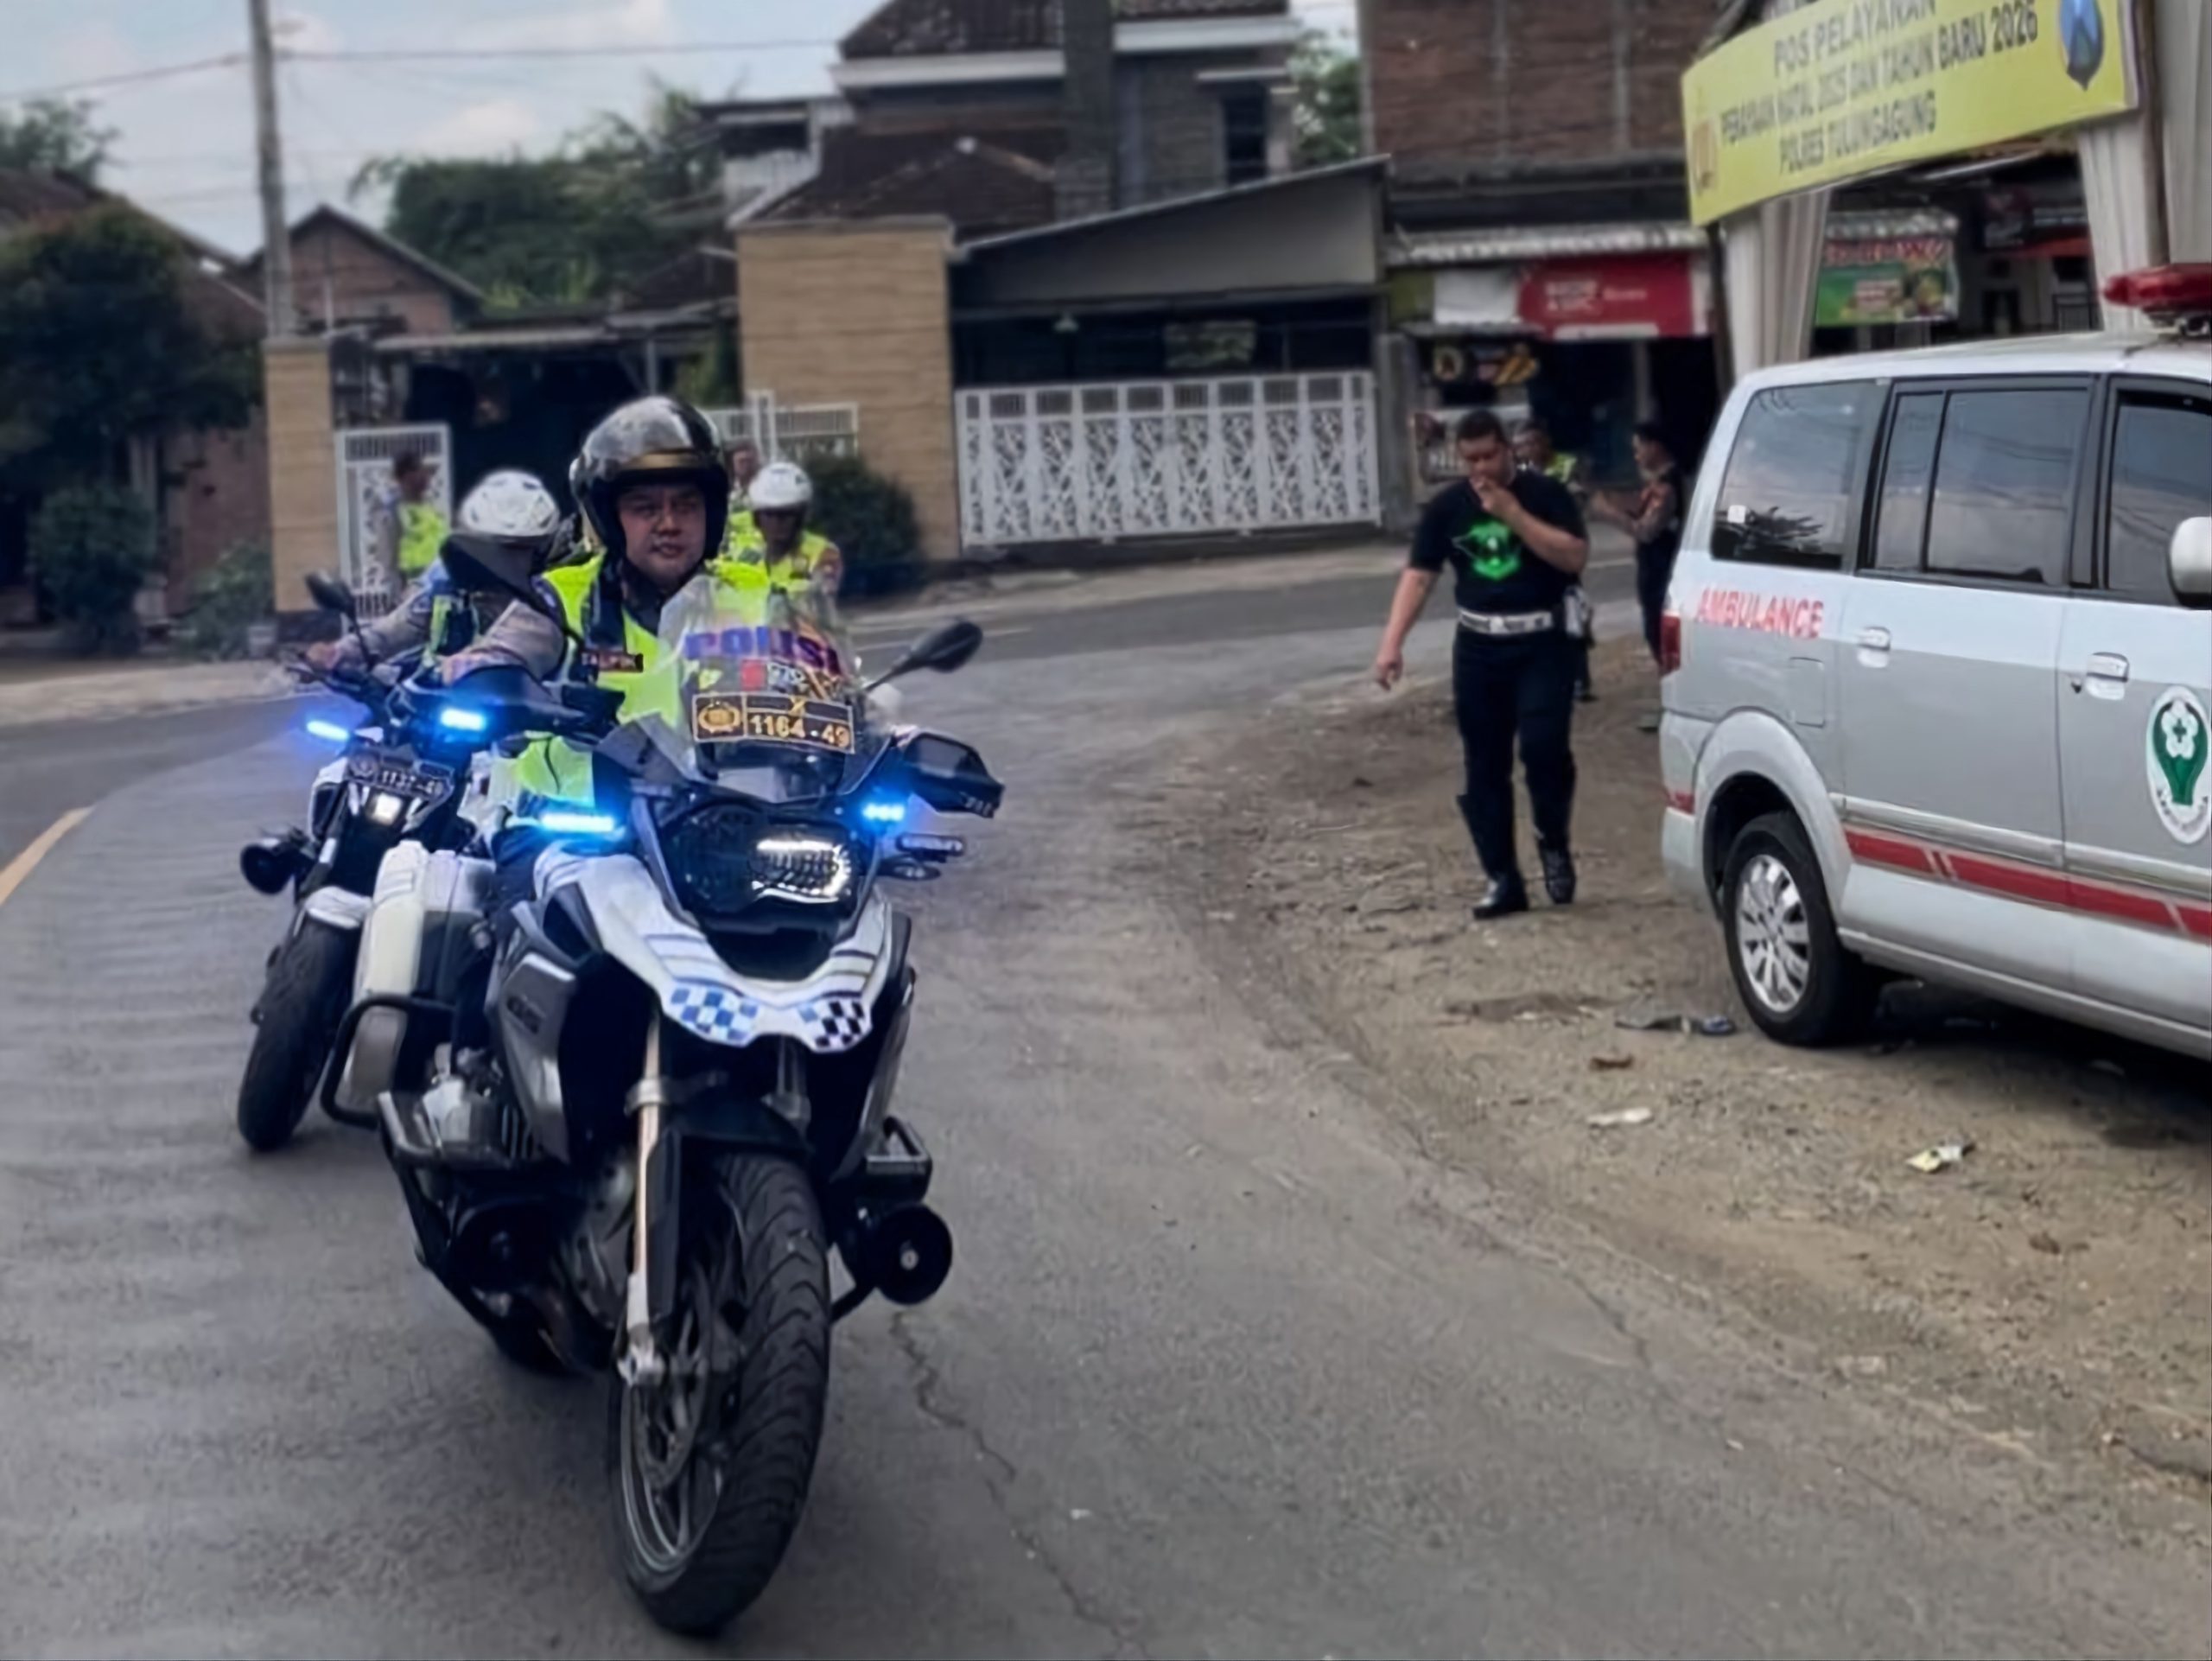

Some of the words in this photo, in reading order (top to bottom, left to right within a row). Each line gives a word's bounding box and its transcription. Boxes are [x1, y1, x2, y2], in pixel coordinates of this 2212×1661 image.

[1774, 31, 1810, 78] POS
[1937, 11, 1986, 70] BARU
[1990, 0, 2038, 54] 2026
[1694, 588, 1824, 639] AMBULANCE
